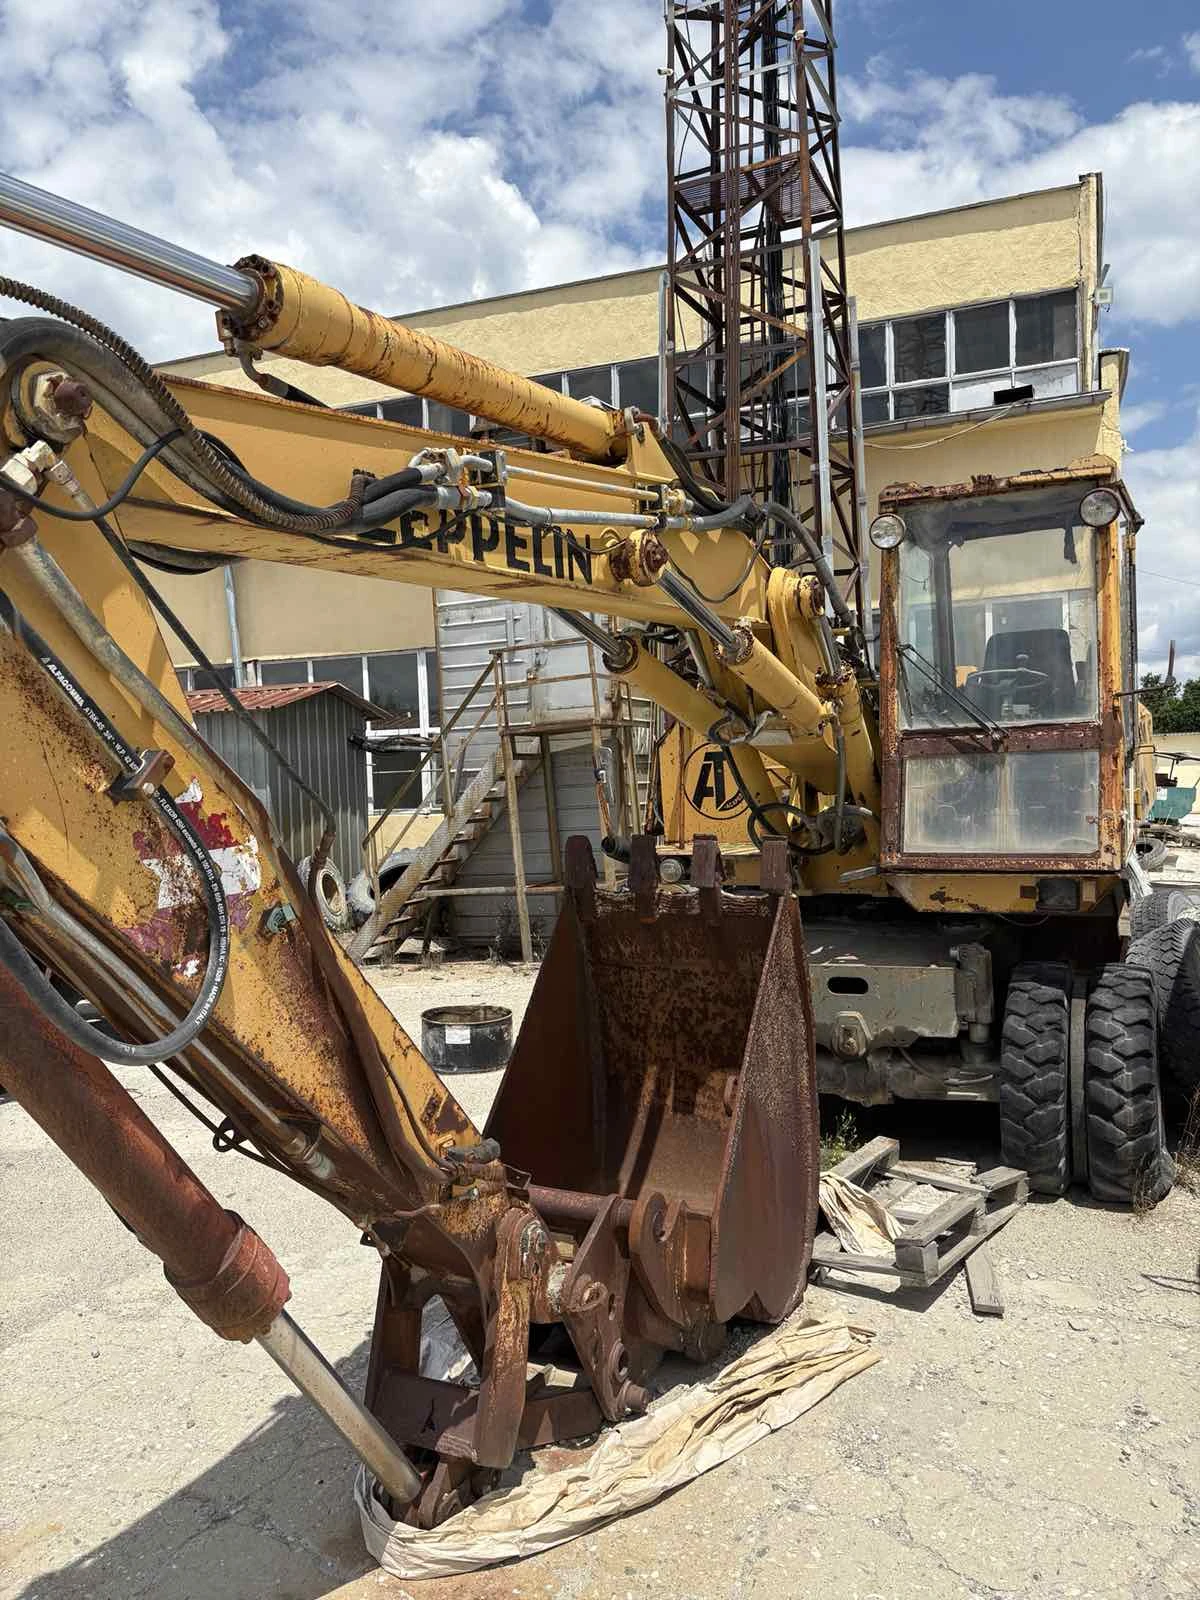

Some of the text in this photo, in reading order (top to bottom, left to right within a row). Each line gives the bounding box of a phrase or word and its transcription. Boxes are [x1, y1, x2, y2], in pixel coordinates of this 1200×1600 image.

[355, 509, 592, 584] EPPELIN
[47, 664, 84, 707] ALFAGOMMA
[160, 798, 178, 820] FLEXOR
[207, 985, 219, 1003] MADE
[194, 1008, 208, 1025] ITALY
